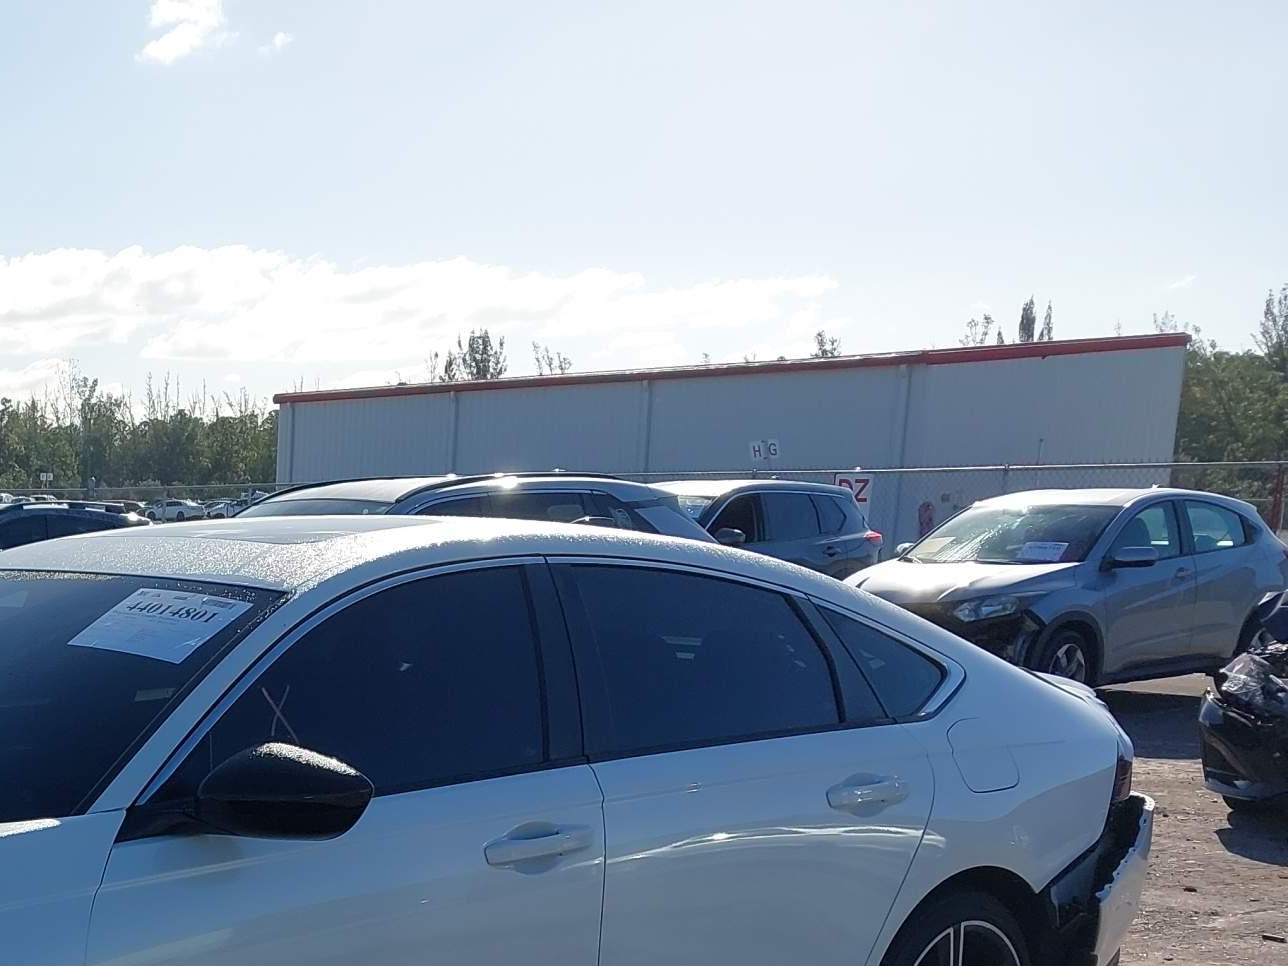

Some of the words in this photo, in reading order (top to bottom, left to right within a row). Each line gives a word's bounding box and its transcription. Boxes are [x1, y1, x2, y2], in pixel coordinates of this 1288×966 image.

[753, 445, 762, 458] H
[769, 443, 777, 456] G
[126, 601, 219, 623] 44014801
